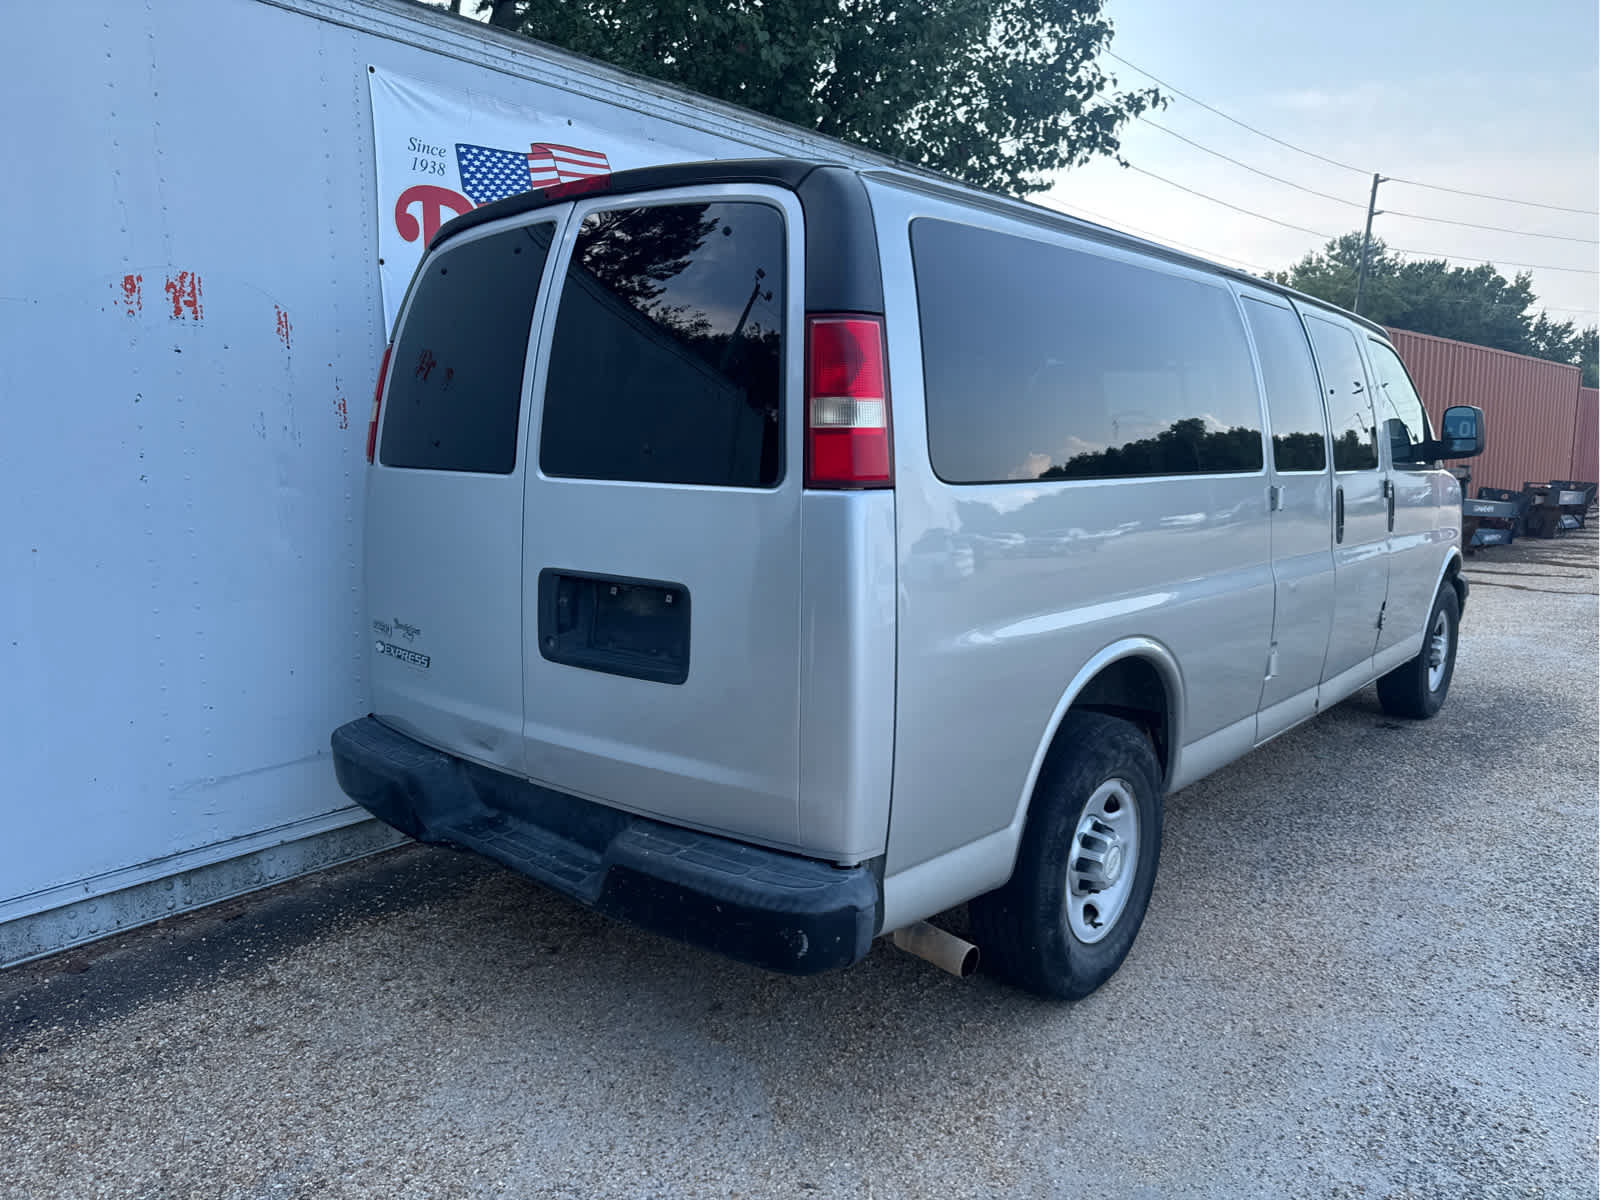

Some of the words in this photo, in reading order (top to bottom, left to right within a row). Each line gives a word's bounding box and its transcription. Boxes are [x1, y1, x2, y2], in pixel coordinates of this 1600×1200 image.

[407, 136, 447, 158] Since
[411, 156, 446, 177] 1938
[384, 643, 430, 668] EXPRESS
